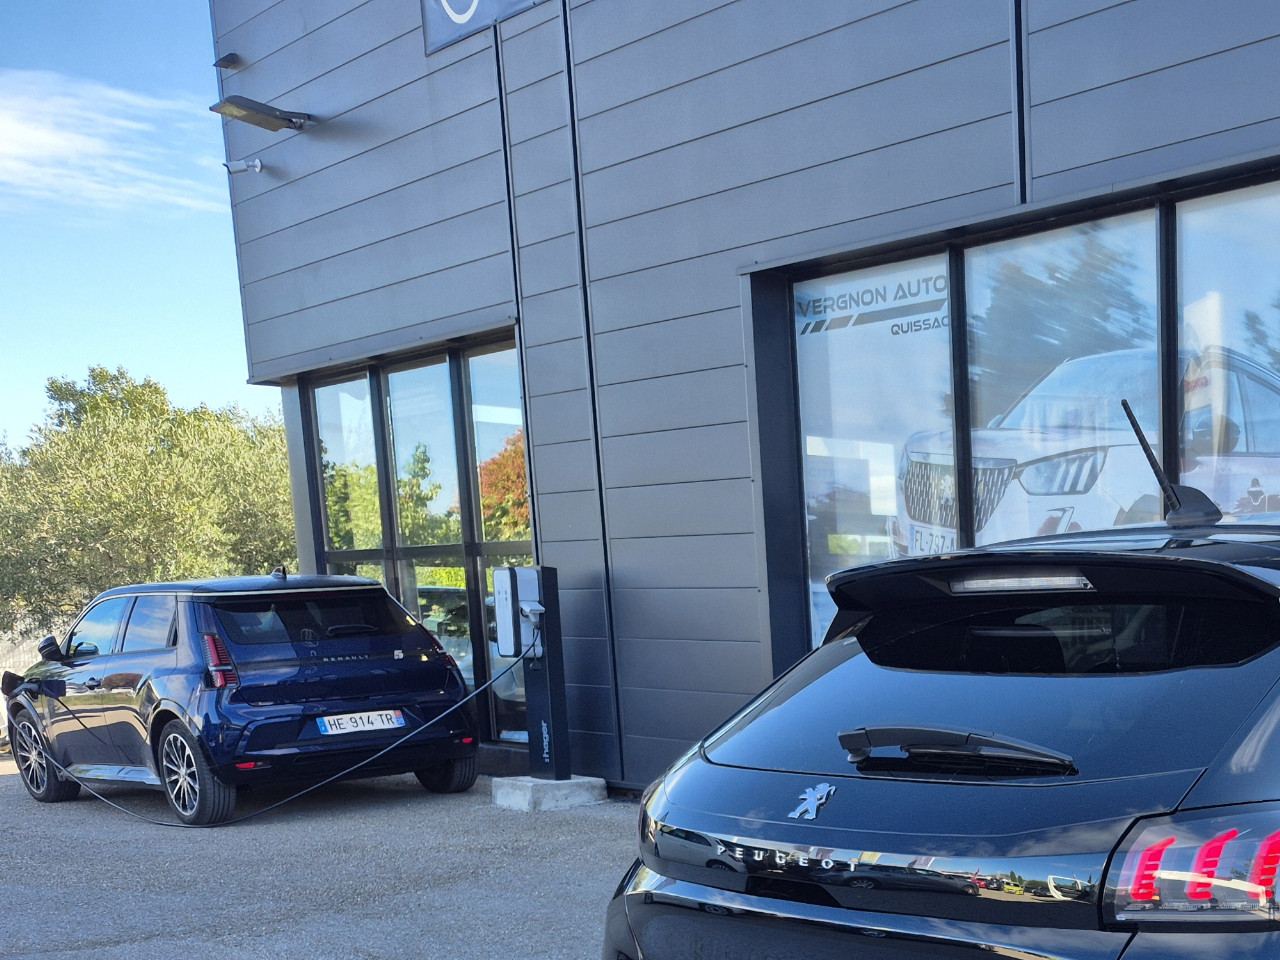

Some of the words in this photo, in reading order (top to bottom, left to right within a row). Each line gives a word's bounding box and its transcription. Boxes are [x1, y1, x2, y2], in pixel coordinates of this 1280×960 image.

[798, 286, 887, 318] VERGNON
[893, 275, 948, 301] AUTO
[891, 316, 949, 336] QUISSAC
[717, 845, 858, 871] PEUGEOT
